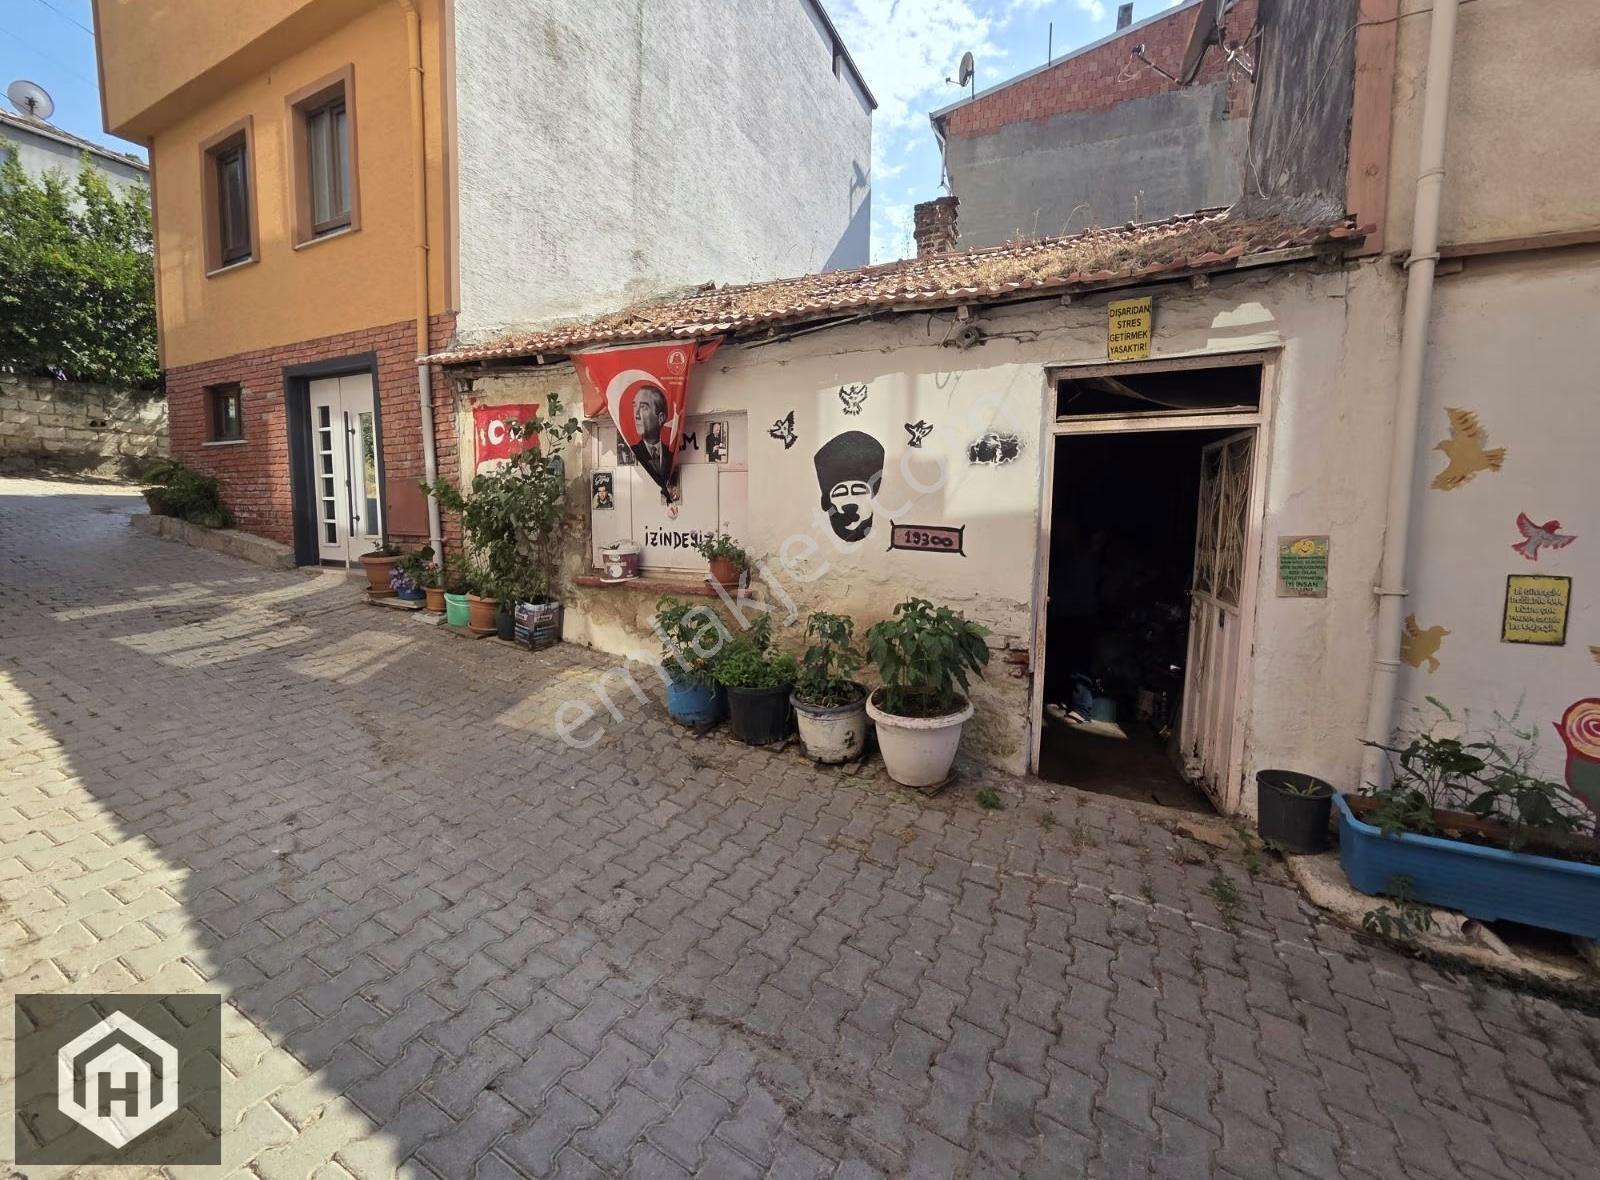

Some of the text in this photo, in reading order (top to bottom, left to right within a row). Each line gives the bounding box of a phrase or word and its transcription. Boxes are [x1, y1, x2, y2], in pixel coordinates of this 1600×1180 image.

[1117, 318, 1142, 329] STRES
[1109, 329, 1148, 343] GETİRMEK
[1110, 342, 1147, 354] YASAKTIR!
